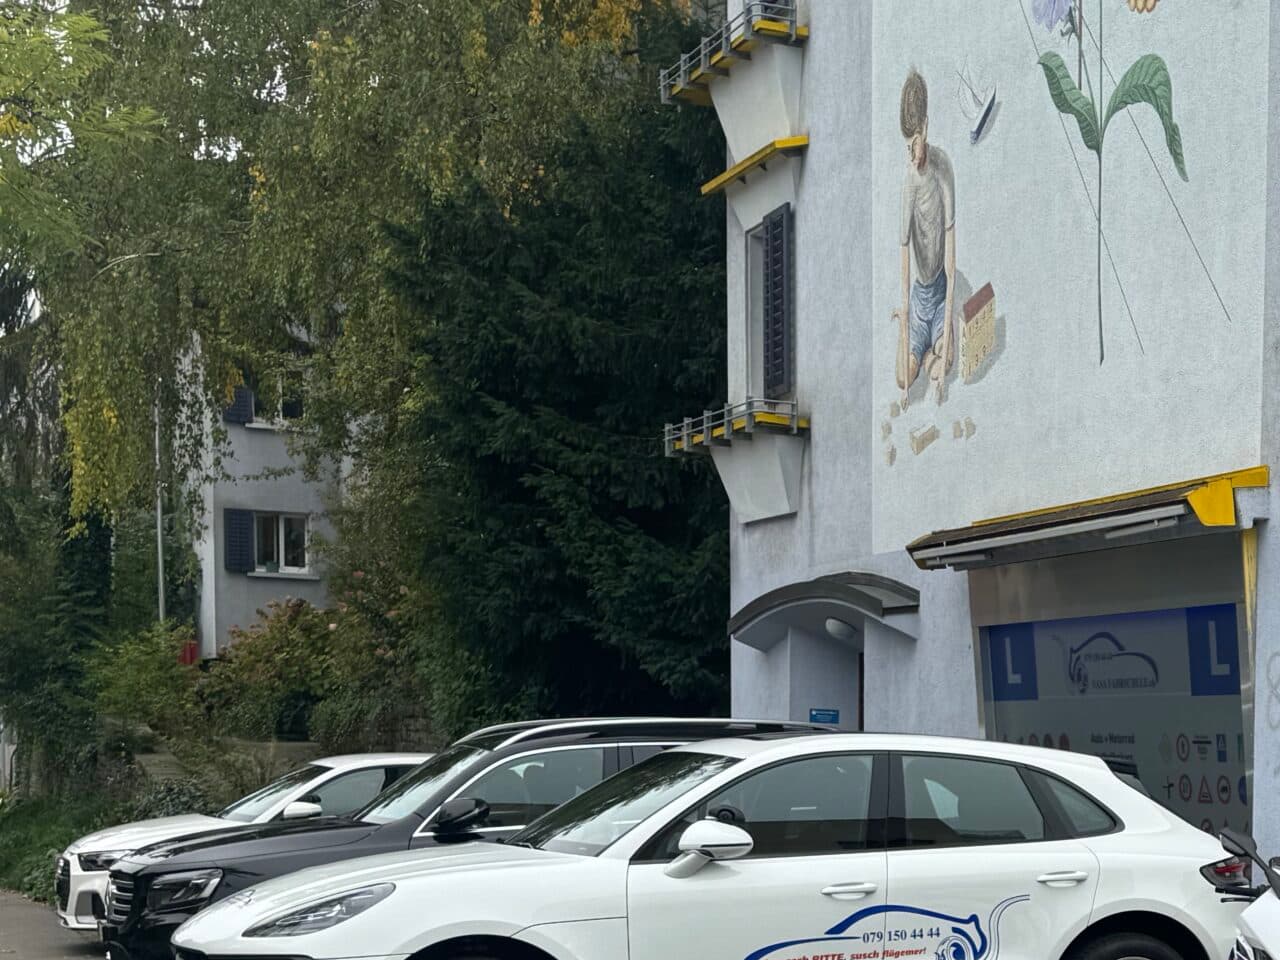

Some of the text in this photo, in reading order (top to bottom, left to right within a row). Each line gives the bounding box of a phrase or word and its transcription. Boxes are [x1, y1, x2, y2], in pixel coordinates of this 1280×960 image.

[1005, 636, 1022, 684] L
[1208, 620, 1231, 676] L
[862, 926, 941, 944] 079 150 44 44
[850, 949, 880, 960] susch
